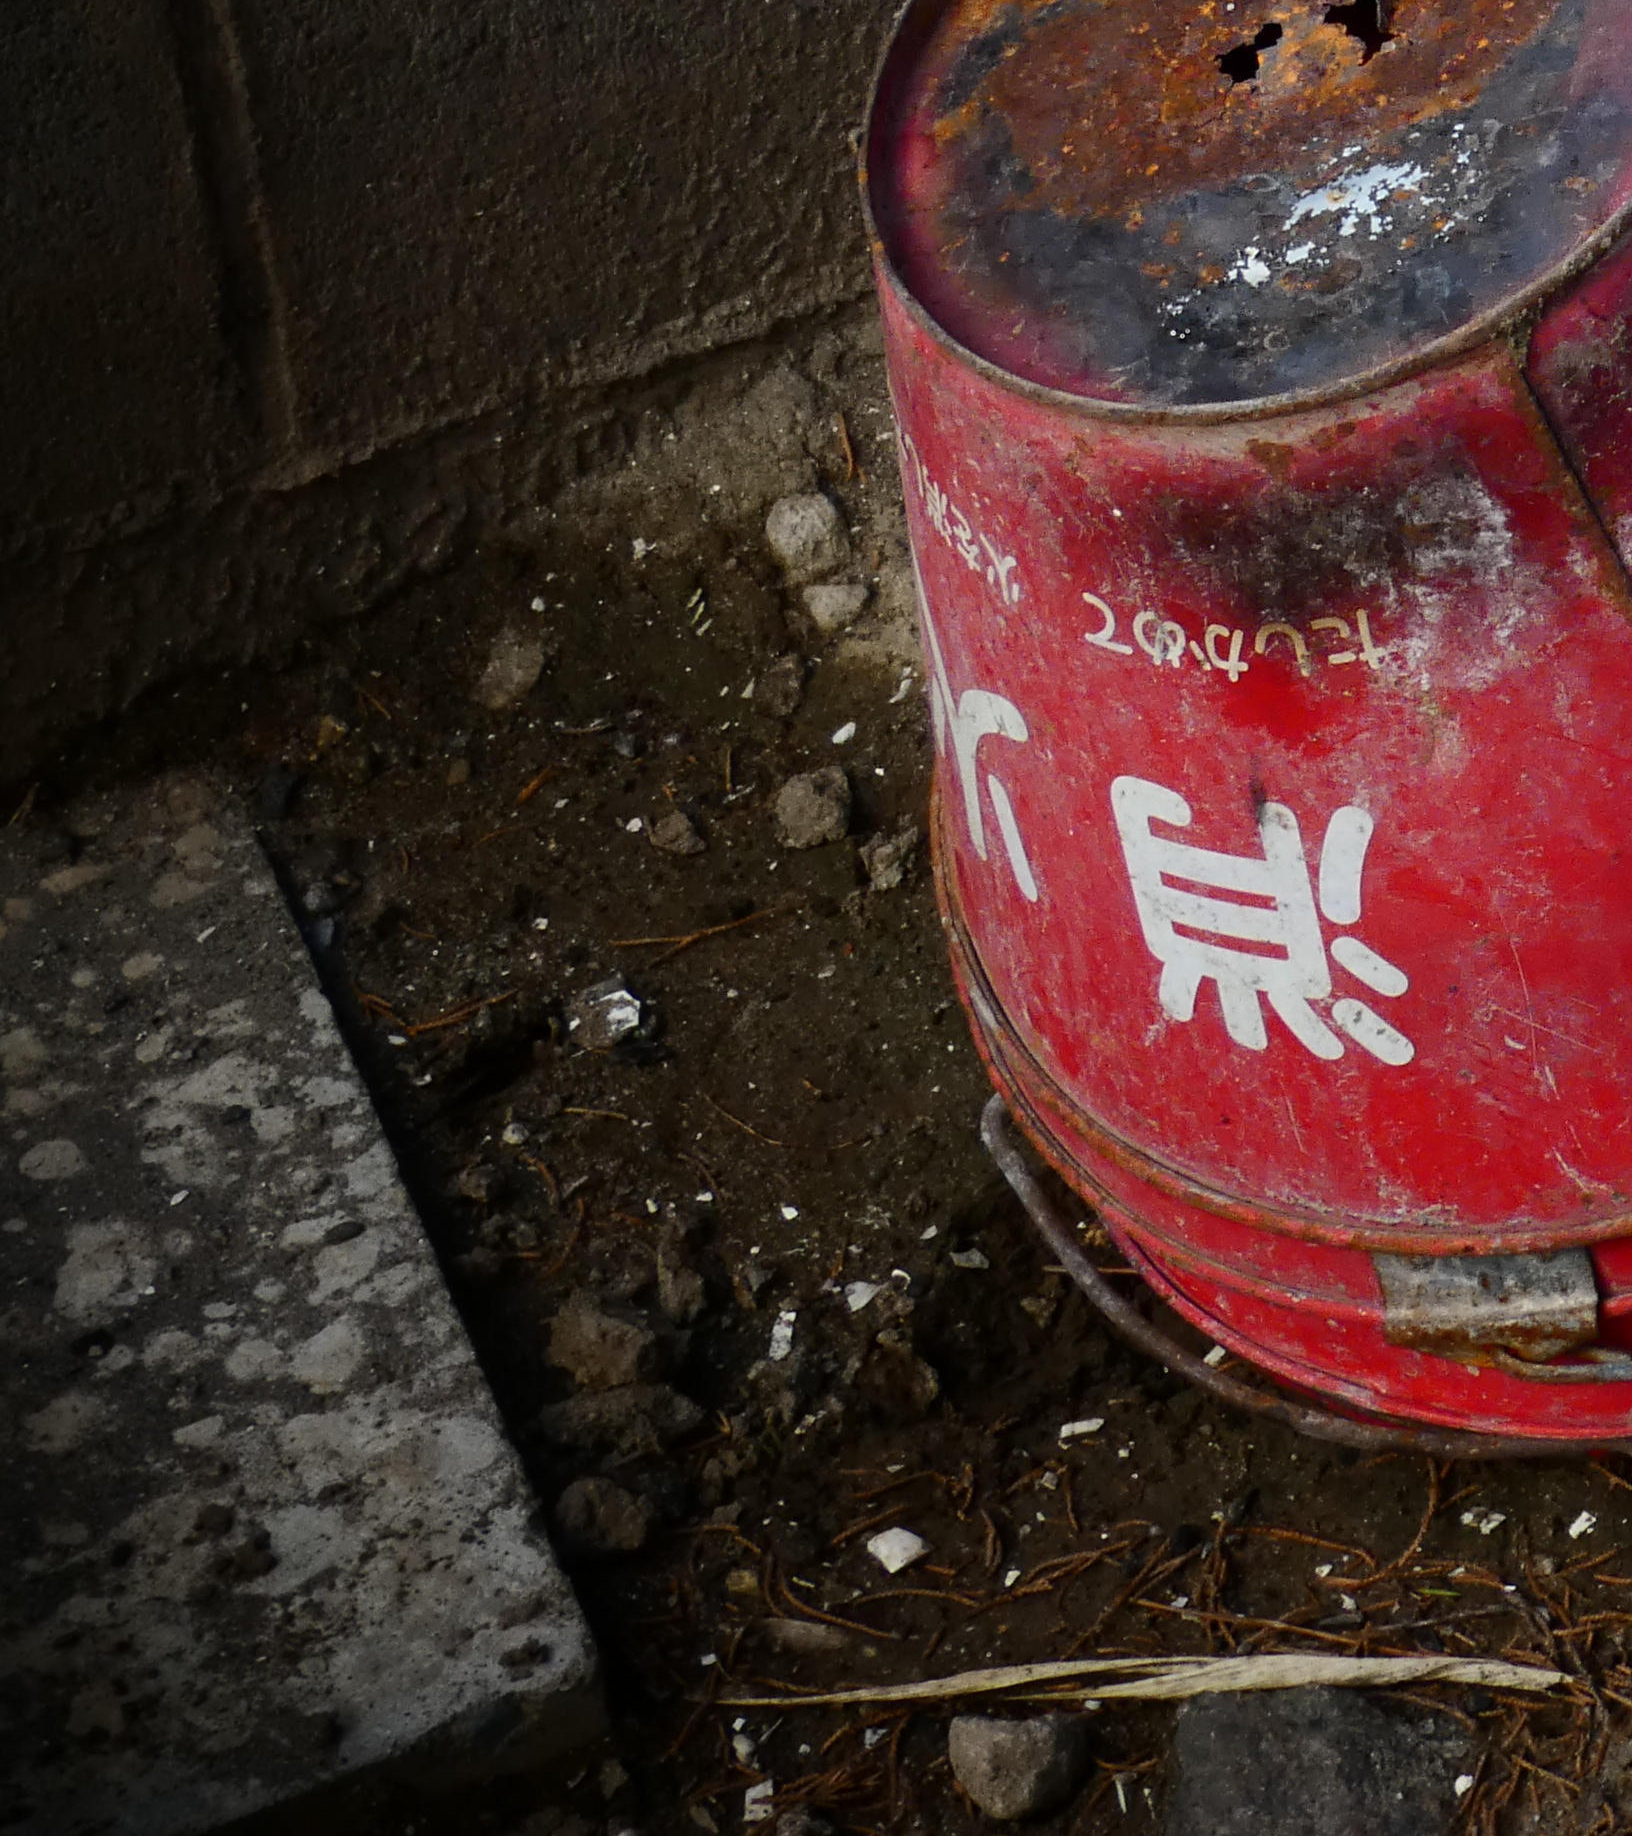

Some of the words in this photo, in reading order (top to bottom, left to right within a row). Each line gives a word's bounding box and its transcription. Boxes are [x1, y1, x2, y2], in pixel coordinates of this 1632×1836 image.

[1081, 592, 1384, 683] たしかめて
